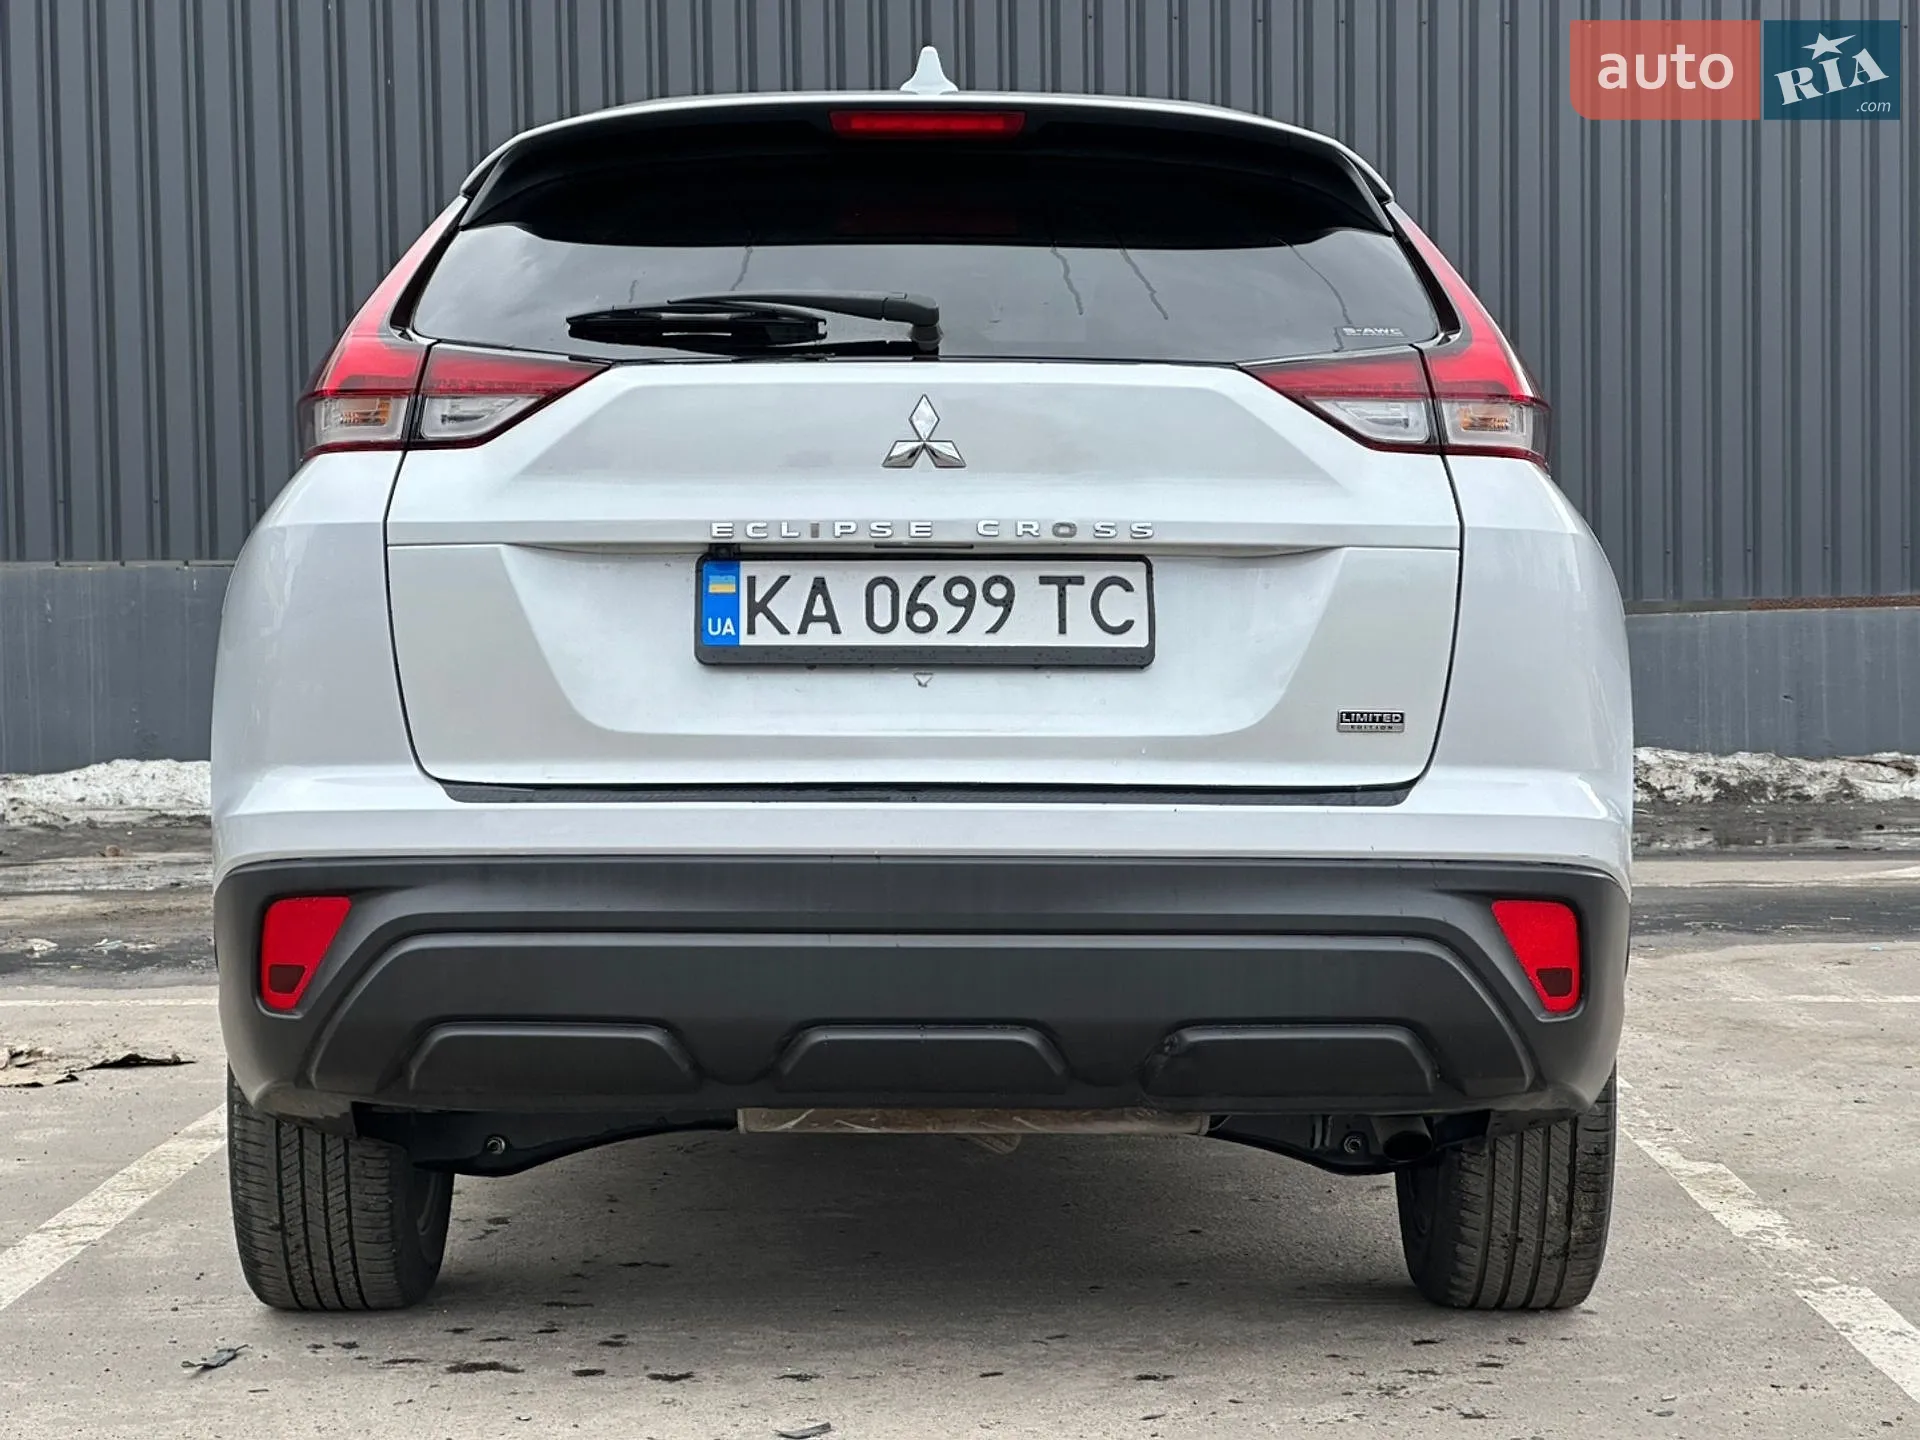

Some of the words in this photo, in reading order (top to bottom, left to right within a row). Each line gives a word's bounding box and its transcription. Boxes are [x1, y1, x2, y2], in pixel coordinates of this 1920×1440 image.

[710, 521, 934, 539] ECLIPSE
[976, 519, 1155, 539] CROSS
[745, 575, 842, 635] KA
[864, 575, 1016, 635] 0699
[1038, 575, 1136, 635] TC
[707, 617, 736, 636] UA
[1341, 713, 1402, 723] LIMITED
